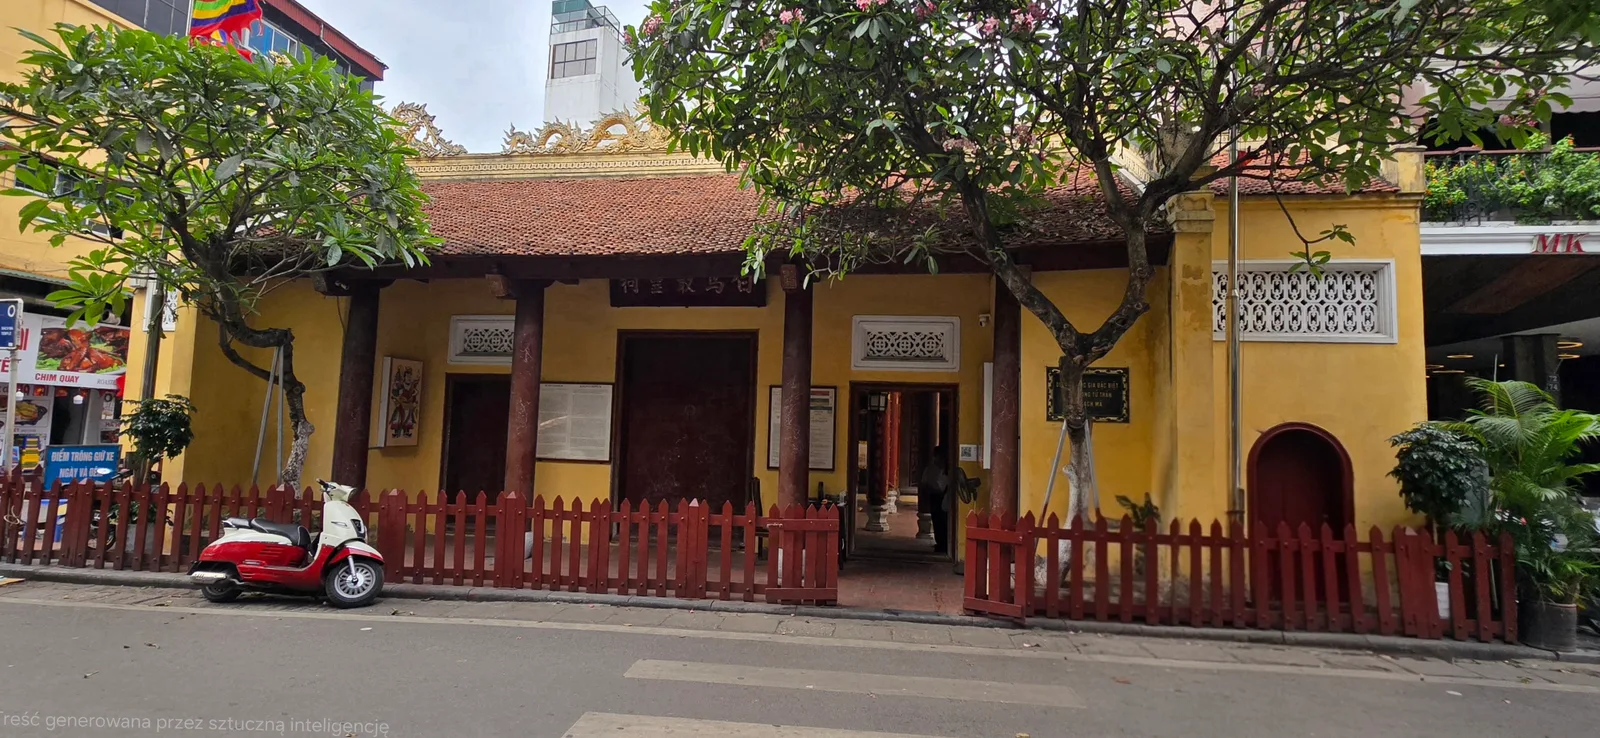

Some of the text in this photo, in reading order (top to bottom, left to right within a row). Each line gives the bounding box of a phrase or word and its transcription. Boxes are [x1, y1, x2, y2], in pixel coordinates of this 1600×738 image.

[1531, 233, 1588, 255] MK
[35, 372, 80, 384] CHIM QUAY
[105, 451, 115, 461] XE
